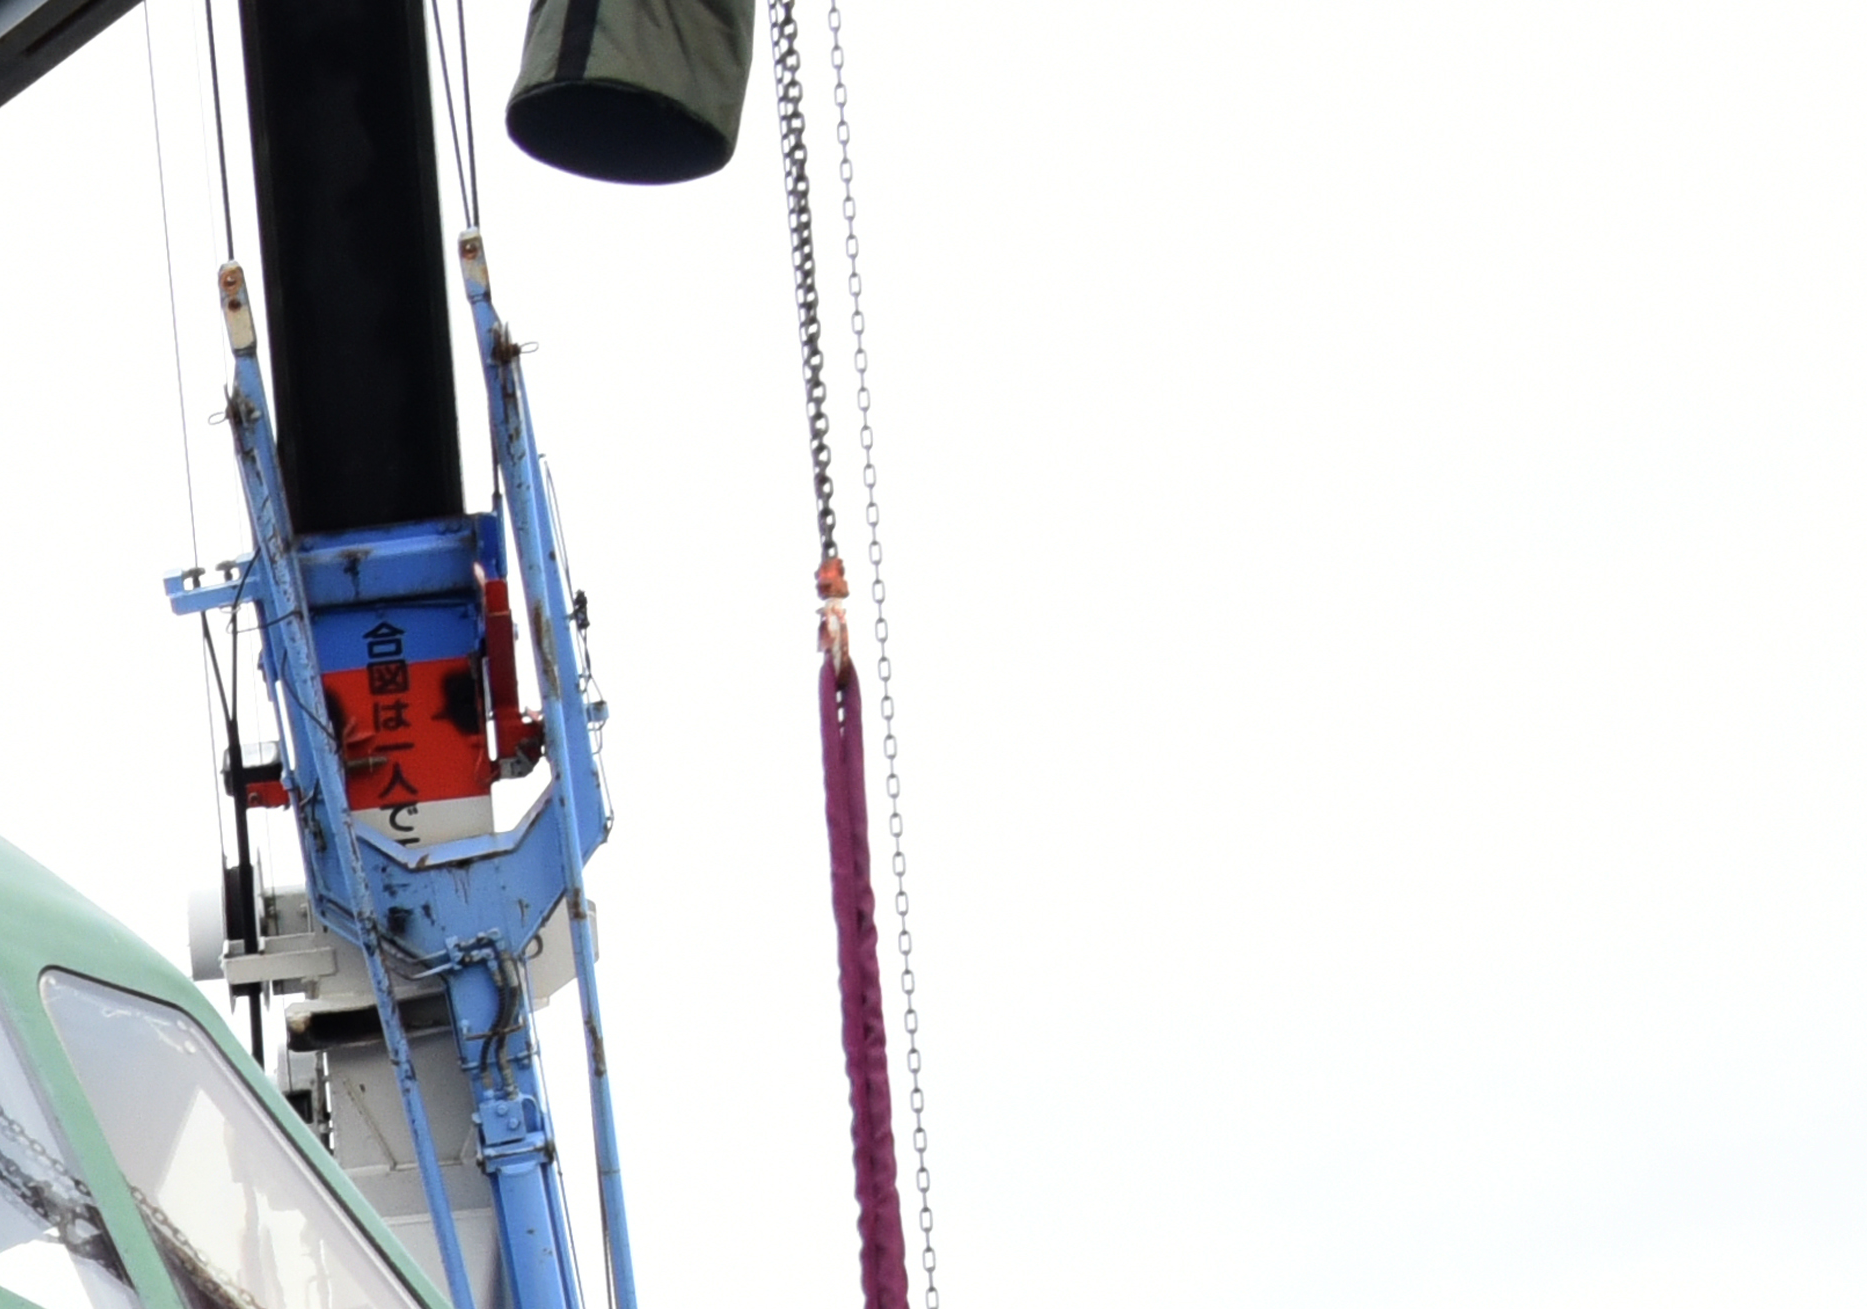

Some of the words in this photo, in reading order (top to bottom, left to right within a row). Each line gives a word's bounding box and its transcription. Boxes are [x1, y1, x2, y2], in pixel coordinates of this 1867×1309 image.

[361, 620, 421, 848] 合図は一人で
